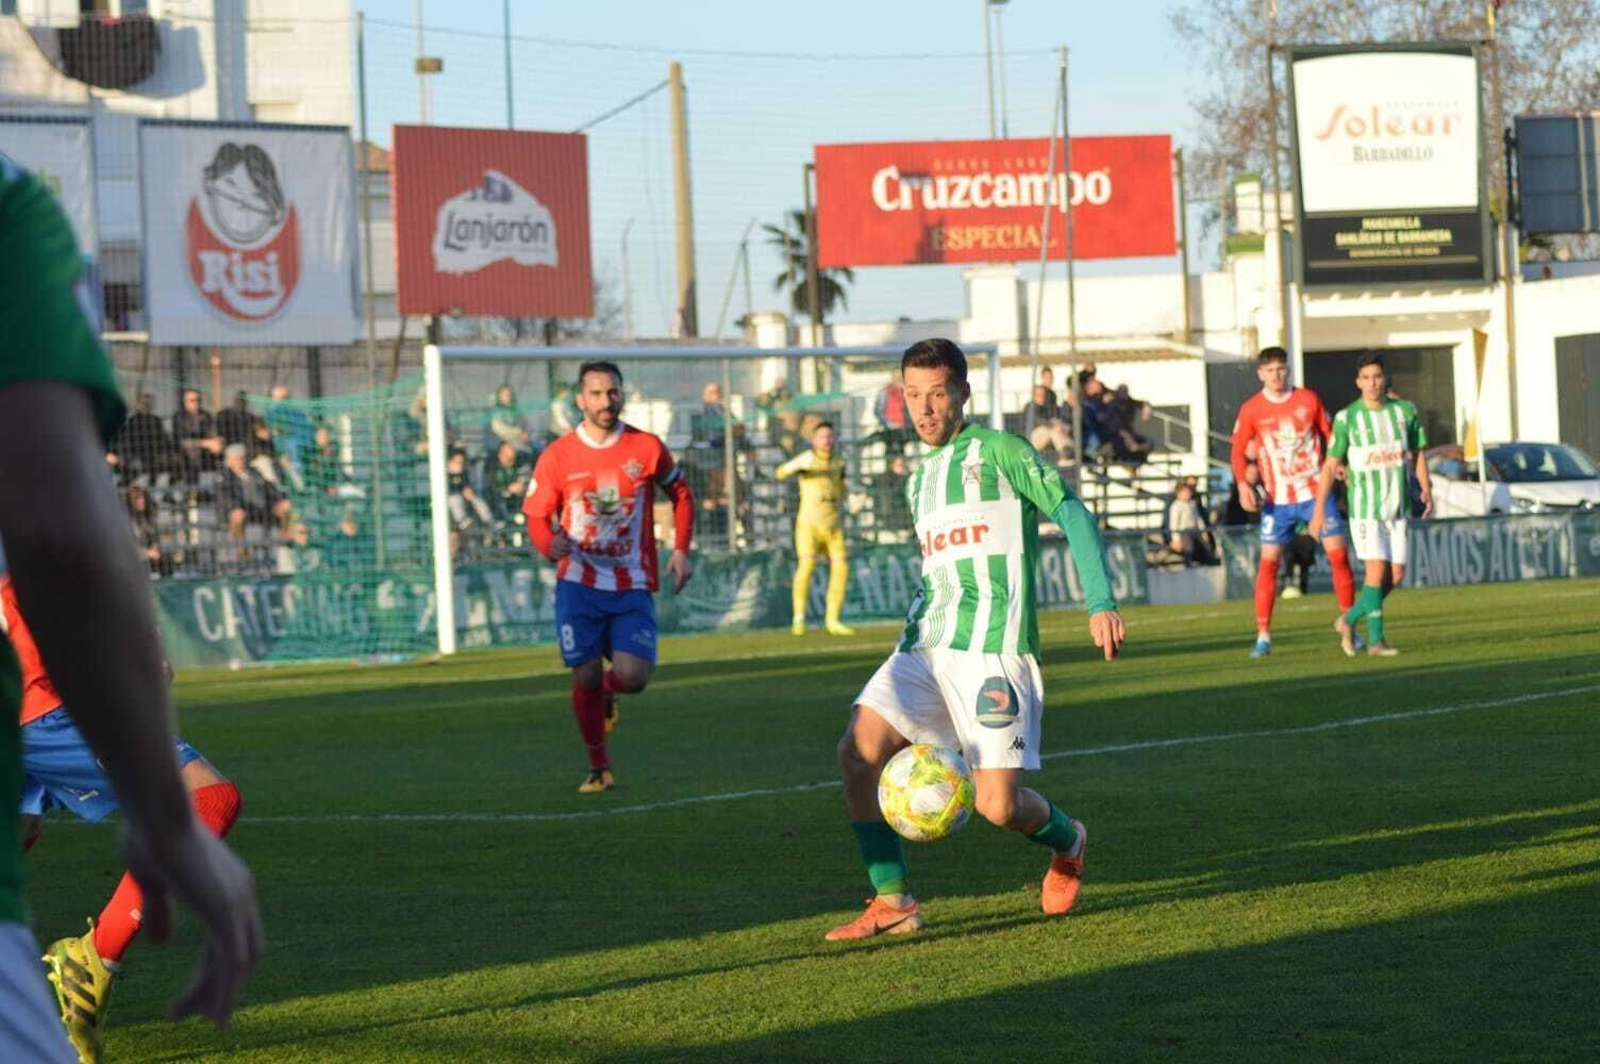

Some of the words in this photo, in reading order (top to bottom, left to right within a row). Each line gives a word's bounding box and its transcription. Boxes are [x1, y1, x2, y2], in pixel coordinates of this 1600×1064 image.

[1314, 102, 1464, 142] Solear
[871, 164, 1111, 213] Cruzcampo
[443, 211, 549, 252] Lanjarón
[198, 250, 281, 300] Risi
[1262, 515, 1275, 535] 3
[561, 624, 575, 650] 8
